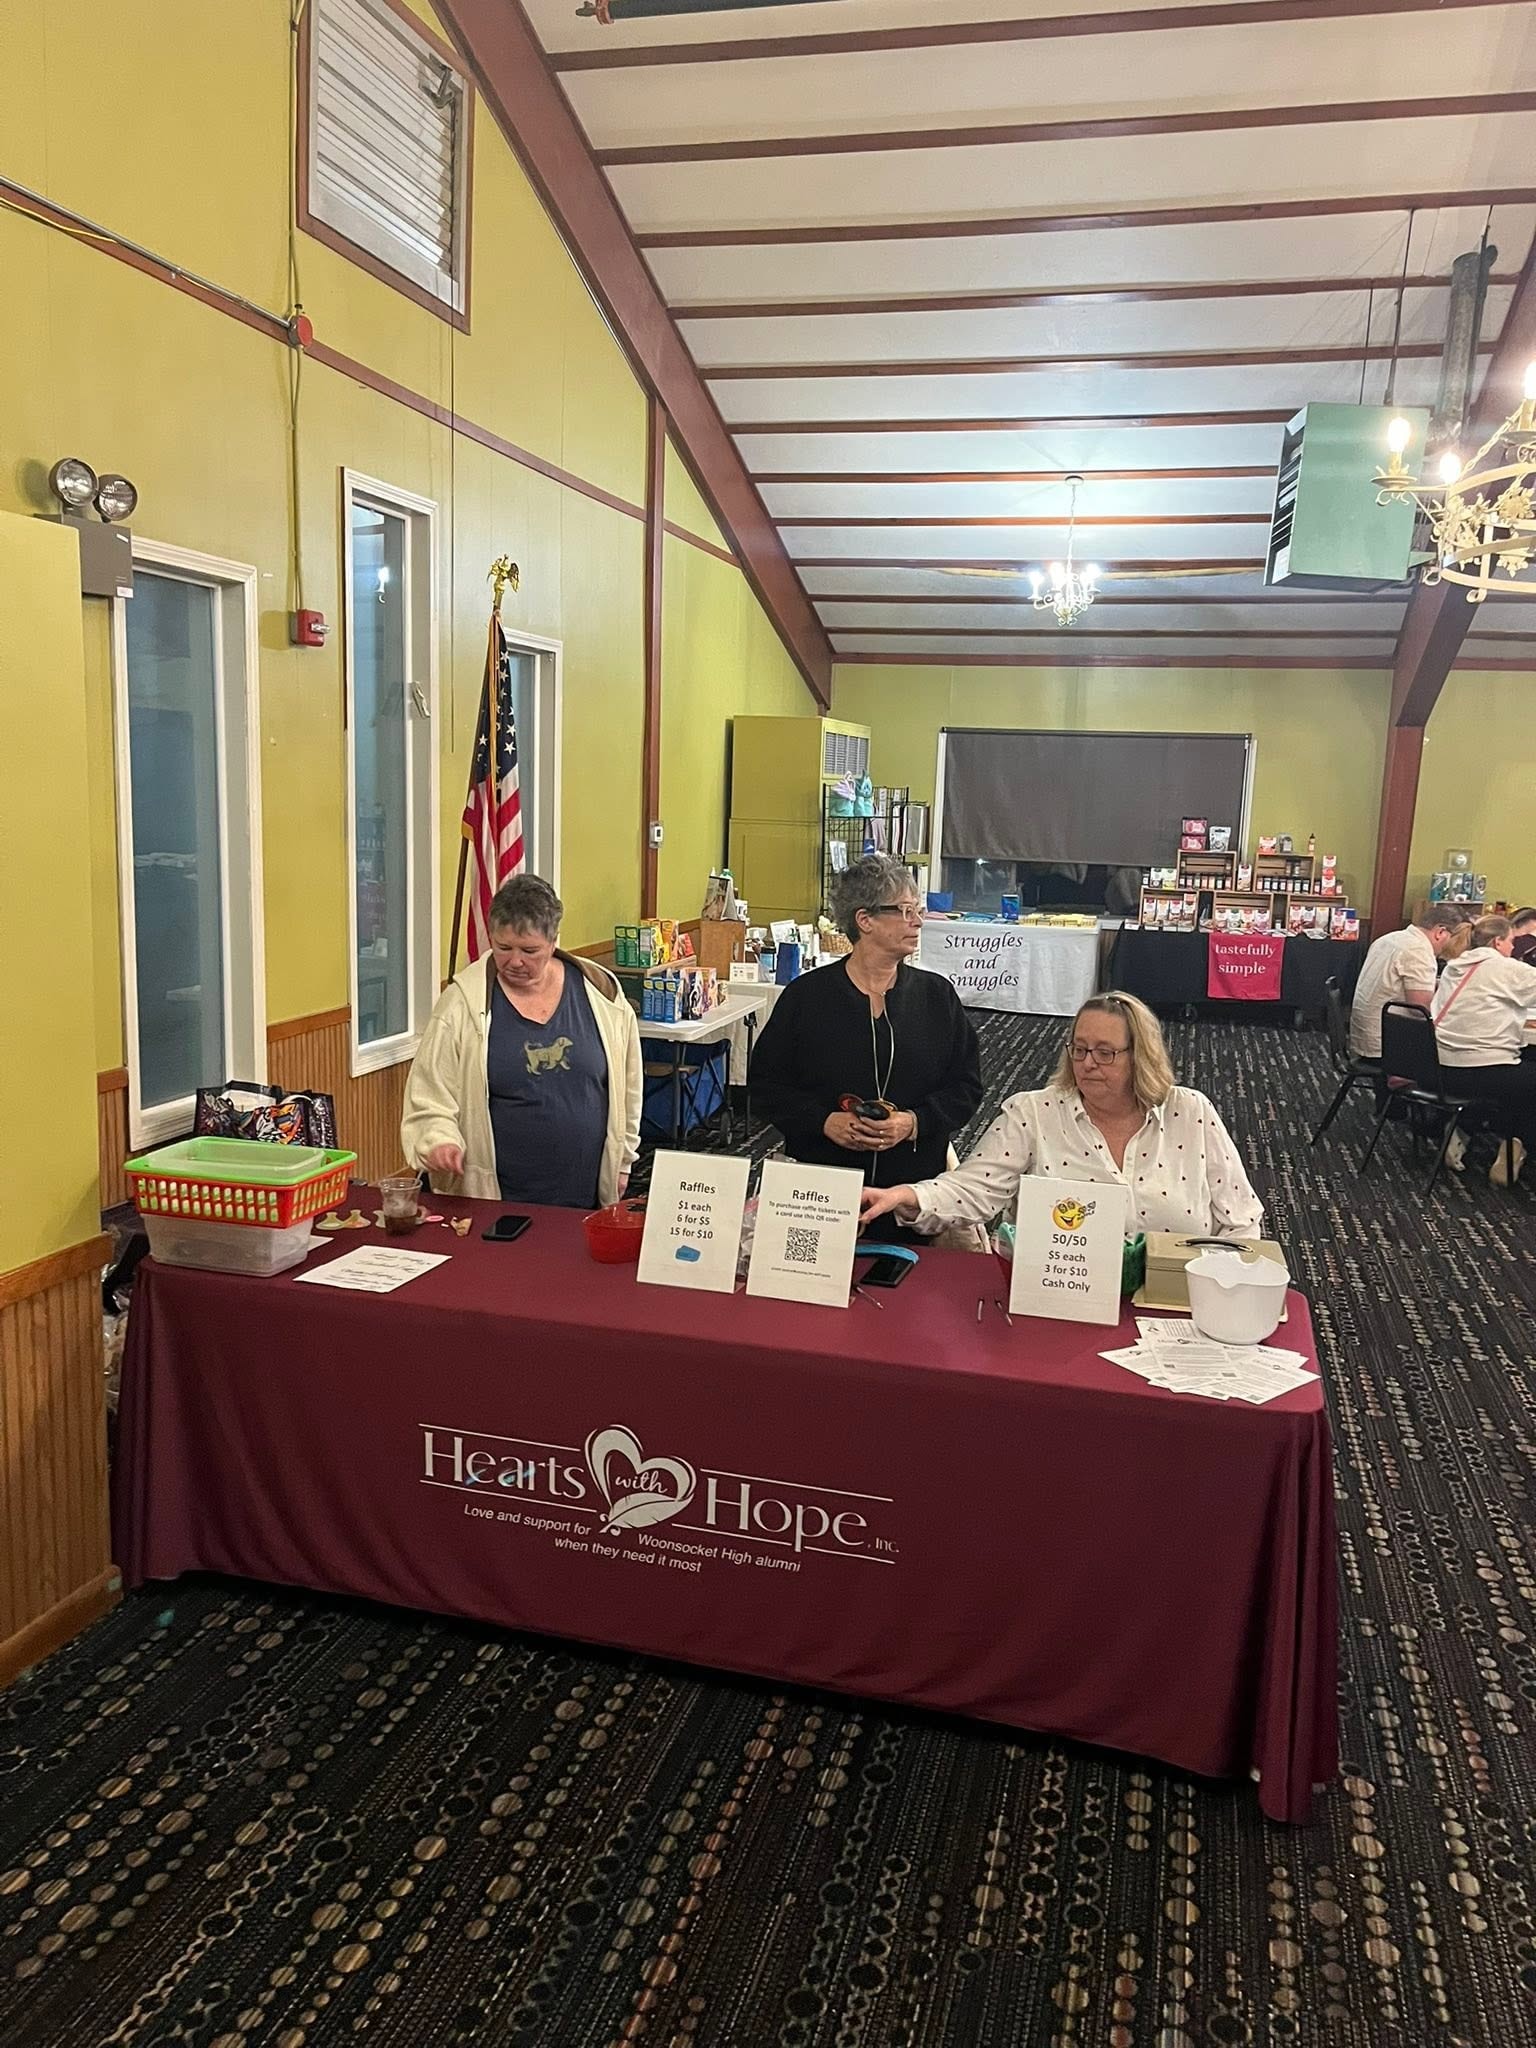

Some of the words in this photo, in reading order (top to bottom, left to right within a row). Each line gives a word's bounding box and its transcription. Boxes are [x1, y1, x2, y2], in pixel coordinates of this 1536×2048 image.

[944, 932, 1023, 953] Struggles
[1215, 943, 1275, 958] tastefully
[964, 954, 1001, 969] and
[1218, 962, 1266, 977] simple
[949, 970, 1019, 991] Snuggles
[680, 1181, 716, 1194] Raffles
[792, 1189, 830, 1203] Raffles
[678, 1200, 688, 1210] $1
[691, 1204, 711, 1212] each
[818, 1207, 836, 1215] tickets
[677, 1214, 683, 1222] 6
[684, 1215, 697, 1224] for
[700, 1216, 710, 1226] $5
[670, 1227, 680, 1236] 15
[682, 1228, 695, 1237] for
[697, 1230, 713, 1239] $10
[1052, 1234, 1087, 1247] 50/50
[1048, 1250, 1061, 1260] $5
[1063, 1253, 1086, 1262] each
[1044, 1264, 1051, 1273] 3
[1053, 1265, 1067, 1275] for
[1069, 1266, 1088, 1277] $10
[1042, 1278, 1065, 1289] Cash
[1067, 1281, 1091, 1293] Only
[424, 1431, 587, 1500] Hearts
[615, 1470, 669, 1494] with
[464, 1504, 495, 1520] Love
[496, 1511, 521, 1525] and
[523, 1514, 571, 1535] support
[573, 1521, 592, 1535] for
[638, 1532, 718, 1558] Woonsocket
[721, 1548, 752, 1565] High
[755, 1554, 801, 1573] alumni
[554, 1536, 590, 1552] when
[591, 1542, 621, 1560] they
[622, 1547, 656, 1565] need
[657, 1554, 667, 1566] it
[668, 1558, 702, 1573] most
